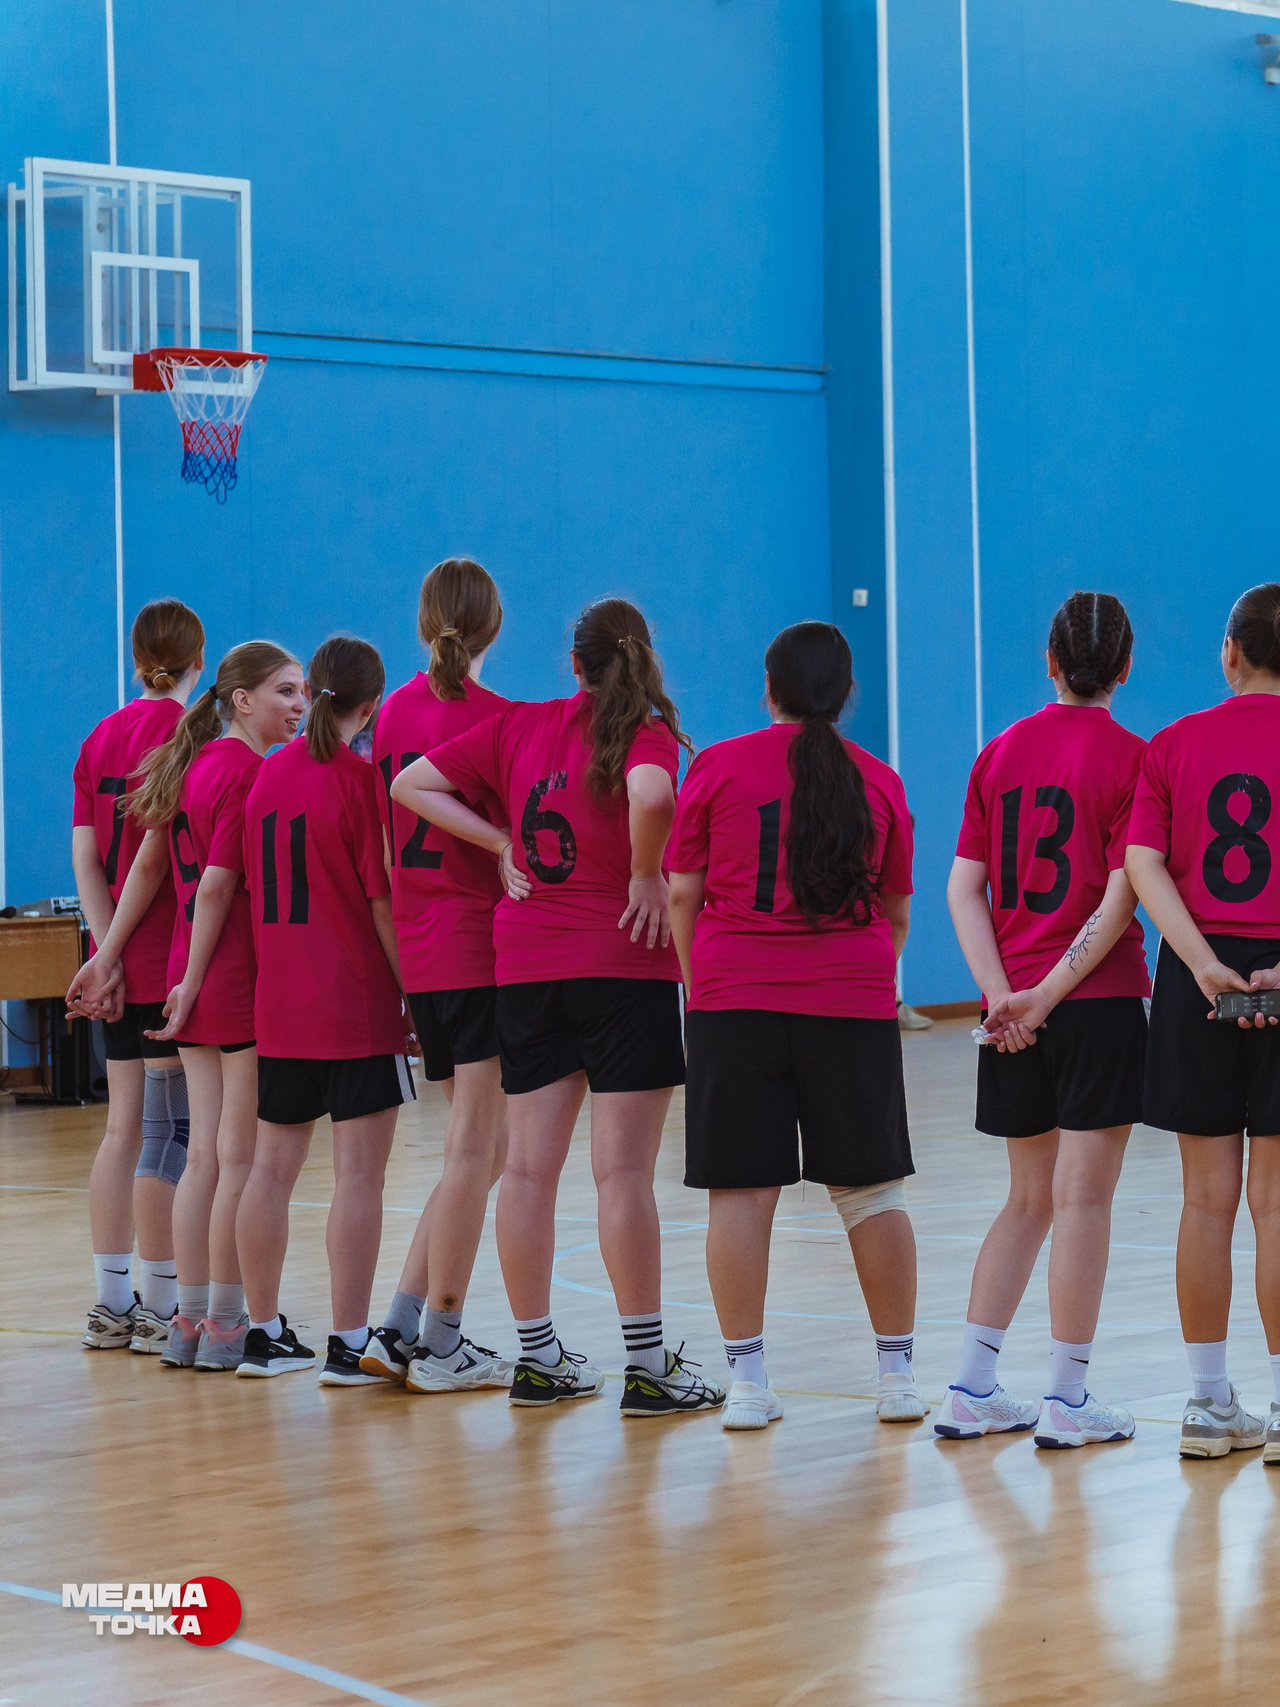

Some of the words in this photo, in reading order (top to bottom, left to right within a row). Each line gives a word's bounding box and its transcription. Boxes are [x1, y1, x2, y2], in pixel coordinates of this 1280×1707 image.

[97, 776, 126, 885] 7
[171, 811, 201, 922] 9
[261, 810, 309, 924] 11
[378, 751, 444, 869] 12
[521, 771, 577, 884] 6
[1000, 785, 1075, 914] 13
[1203, 773, 1272, 903] 8
